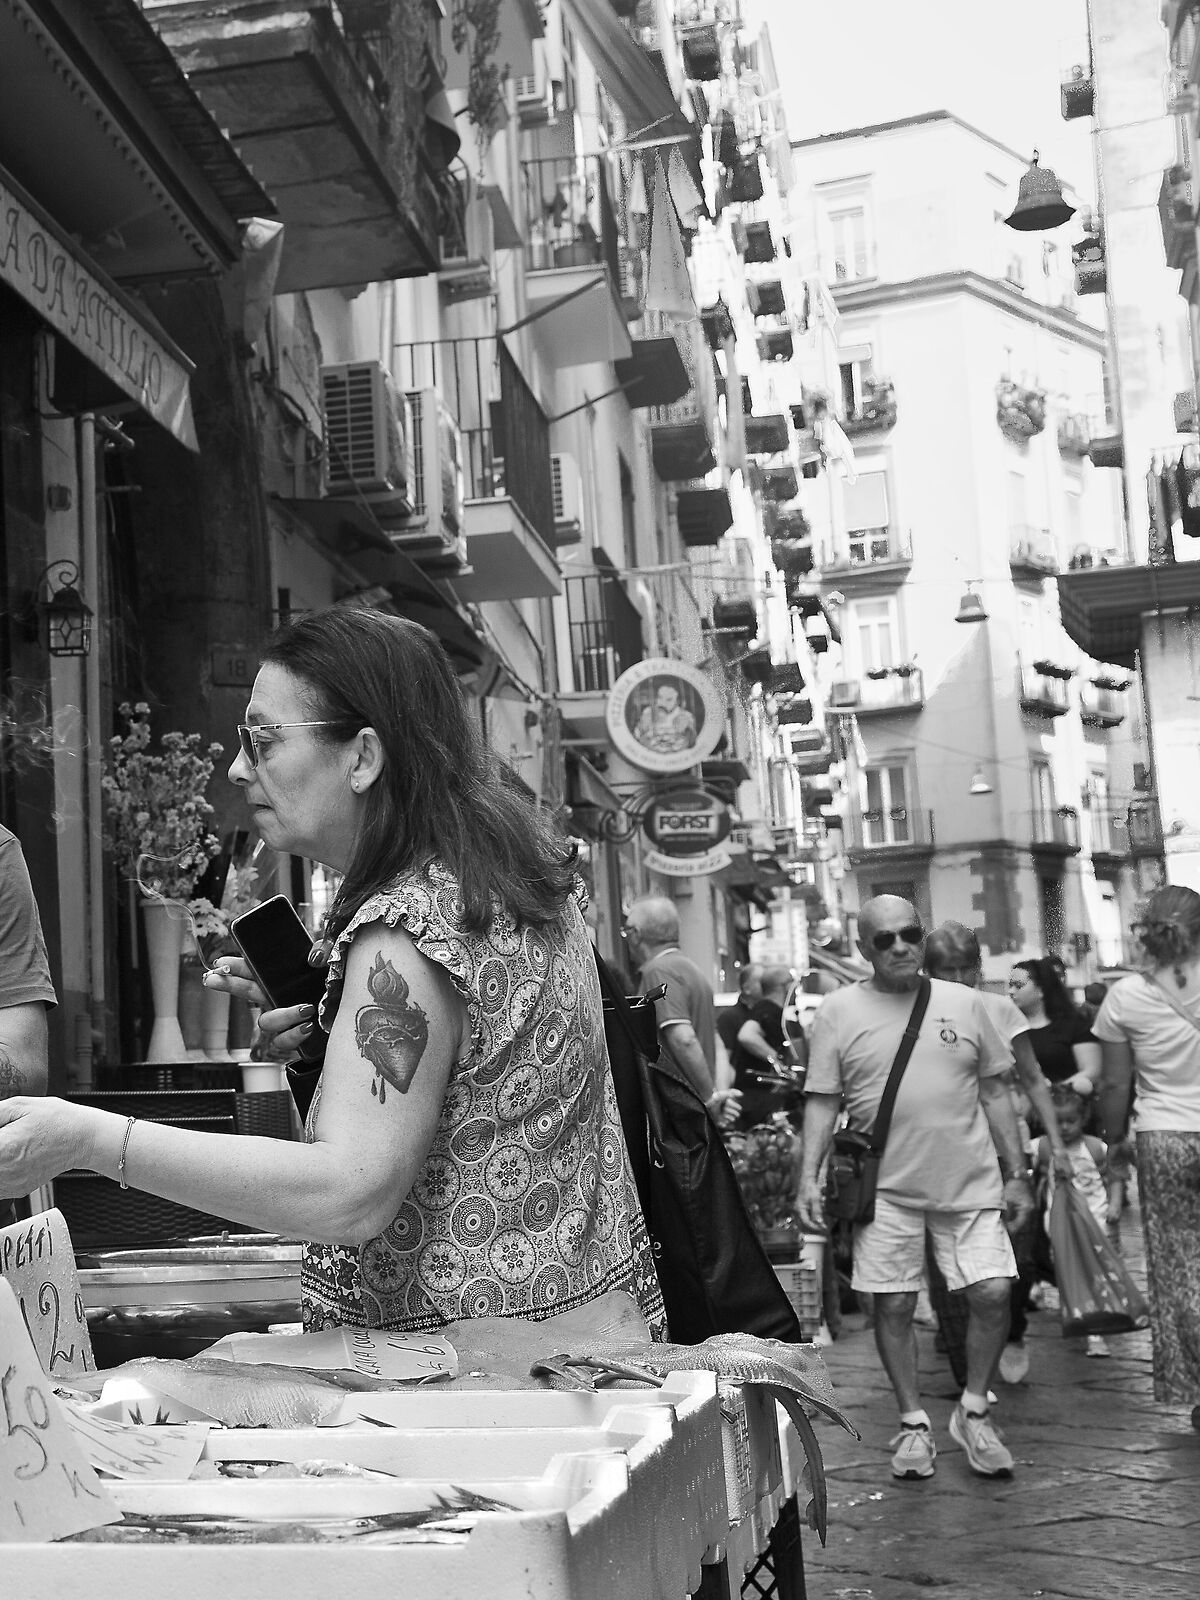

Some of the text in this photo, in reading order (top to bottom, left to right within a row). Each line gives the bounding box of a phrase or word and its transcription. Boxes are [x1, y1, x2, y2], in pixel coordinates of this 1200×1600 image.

[71, 277, 162, 405] ATTILIO
[227, 659, 247, 677] 18
[659, 814, 714, 830] FORST
